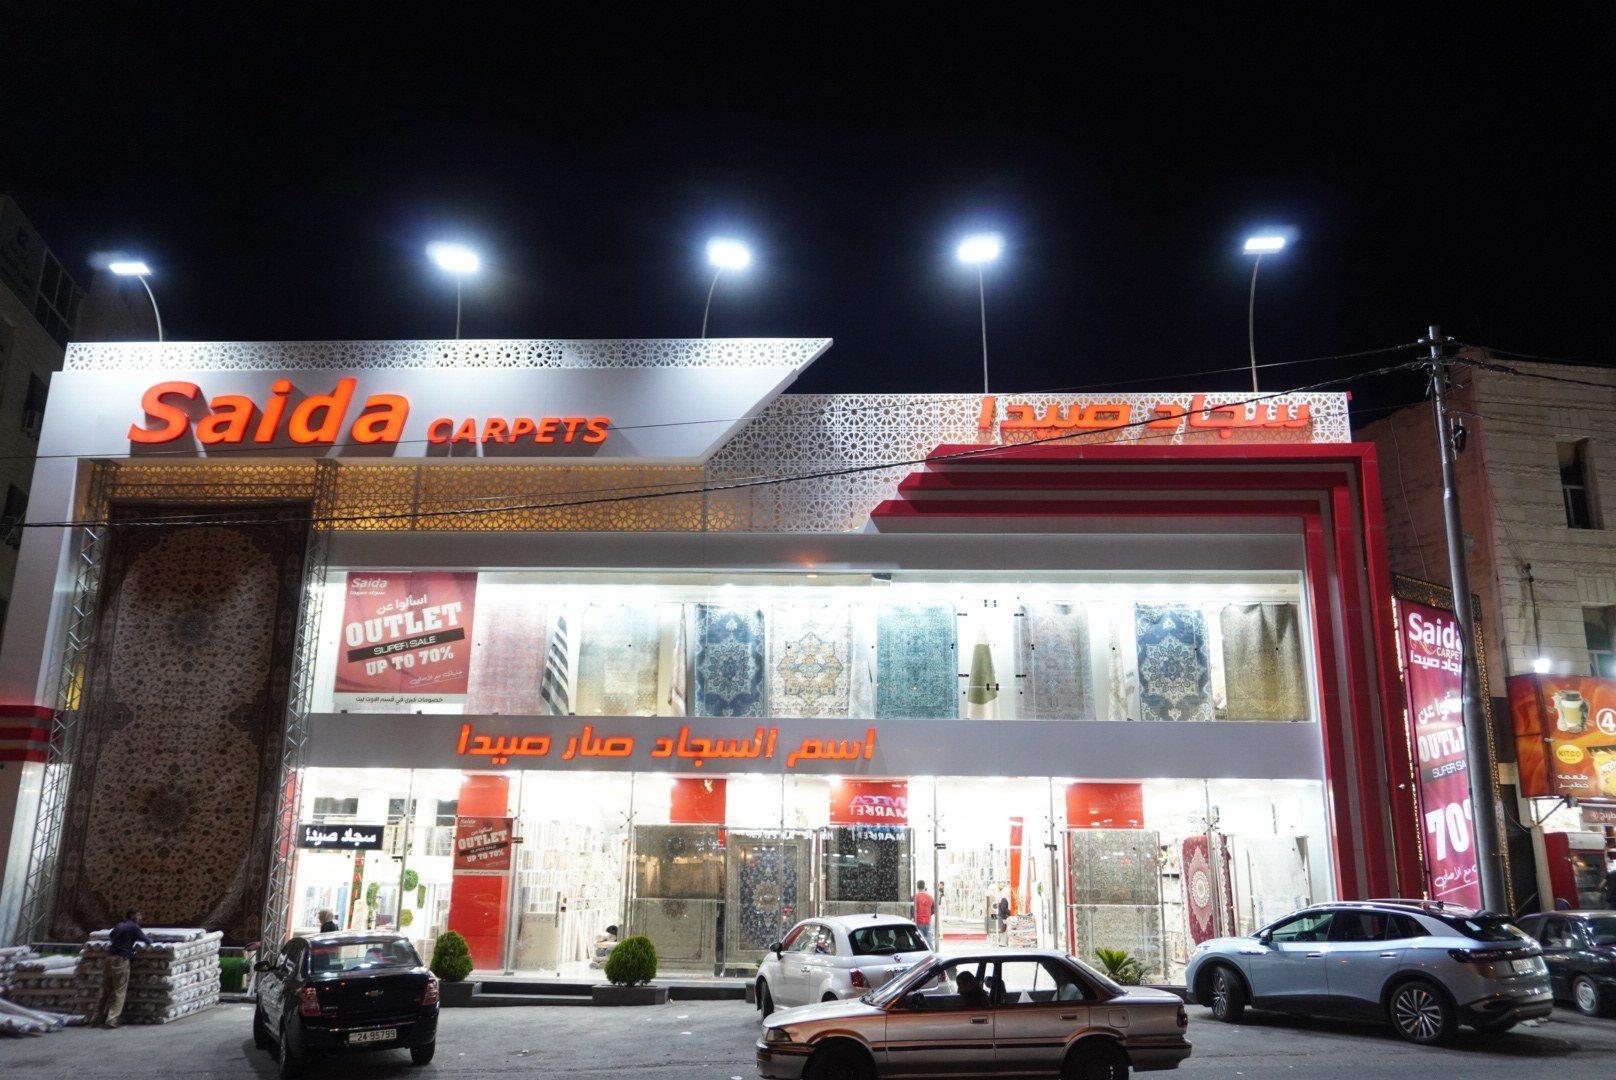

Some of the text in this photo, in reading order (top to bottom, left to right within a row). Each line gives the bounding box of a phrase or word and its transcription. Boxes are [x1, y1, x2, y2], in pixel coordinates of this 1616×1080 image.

[128, 377, 611, 446] Saida CARPETS
[977, 393, 1312, 440] سجاد صيدا
[352, 578, 388, 588] Saida
[376, 604, 394, 615] عن
[345, 601, 462, 647] OUTLET
[373, 635, 437, 655] SUPER SALE
[1436, 646, 1462, 661] CARPE
[365, 645, 454, 676] UP TO 70%
[1410, 650, 1440, 670] صيدا
[456, 723, 877, 767] اسم السجاد صار صيدا
[1418, 726, 1466, 762] OUTL
[1432, 762, 1456, 778] SUPER
[305, 827, 377, 846] سجاد صيدا
[458, 830, 507, 850] OUTLET
[478, 852, 488, 860] TO
[489, 849, 505, 858] 70%
